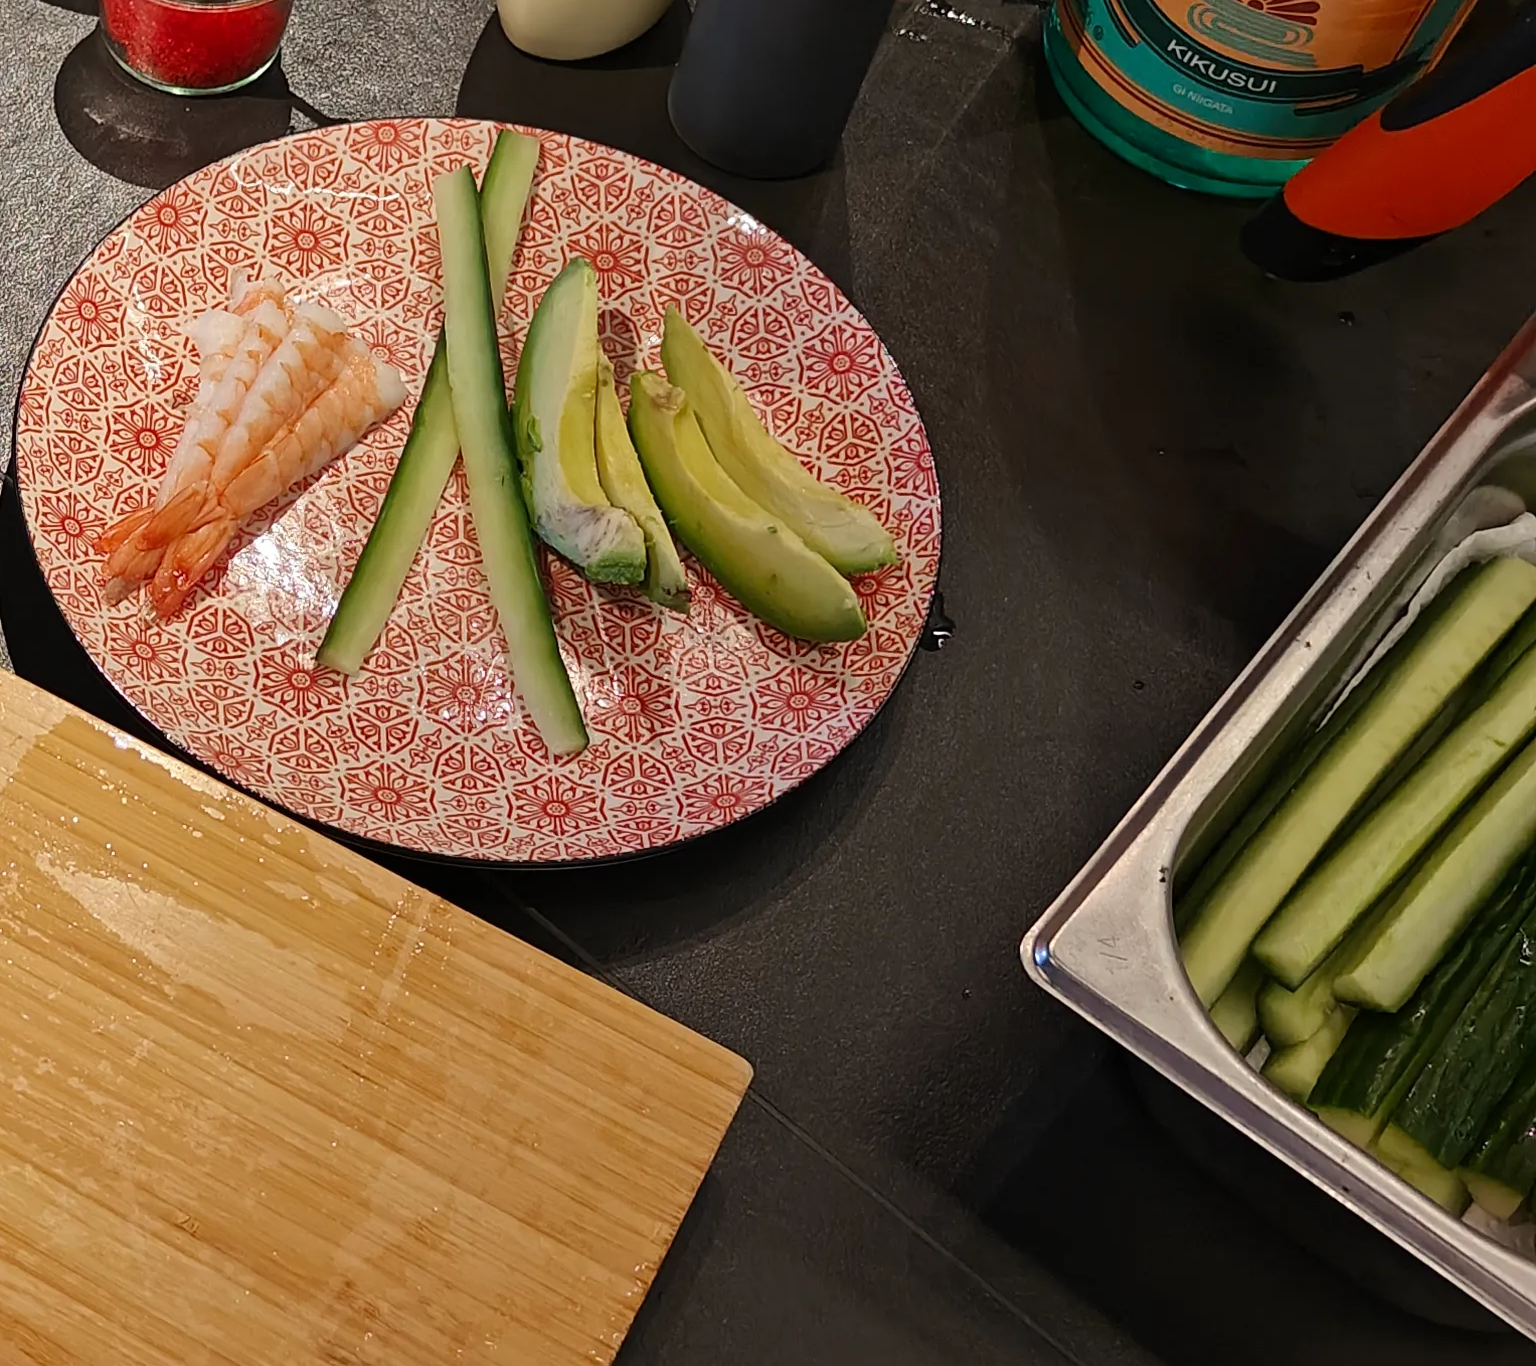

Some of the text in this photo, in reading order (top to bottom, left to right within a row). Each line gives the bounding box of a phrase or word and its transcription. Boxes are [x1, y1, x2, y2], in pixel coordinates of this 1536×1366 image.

[1167, 38, 1278, 94] KIKUSUI
[1172, 83, 1234, 115] GI NIIGATA
